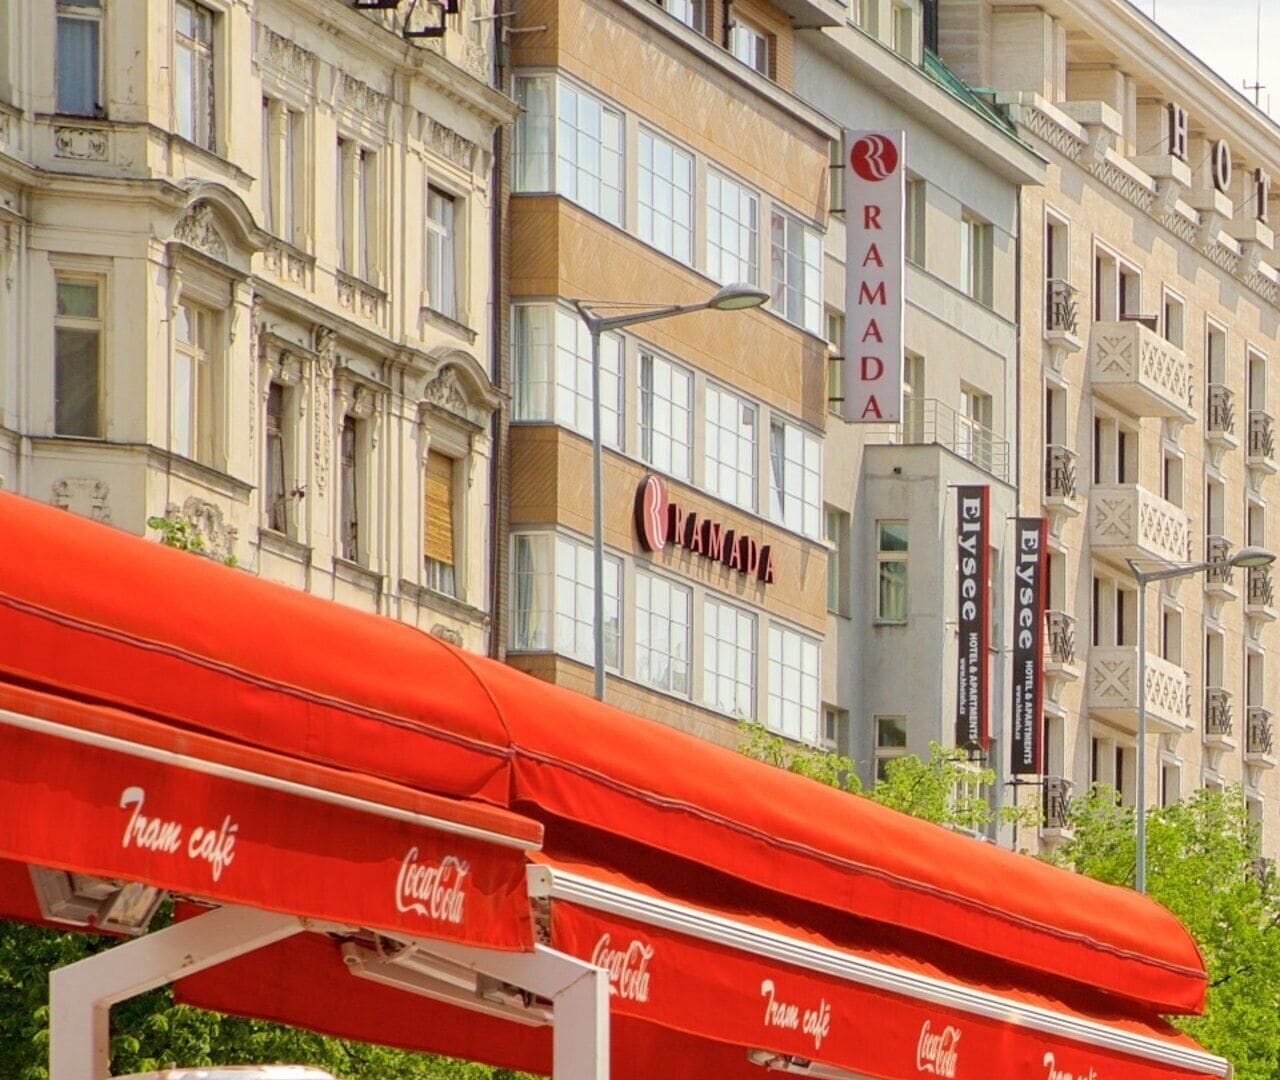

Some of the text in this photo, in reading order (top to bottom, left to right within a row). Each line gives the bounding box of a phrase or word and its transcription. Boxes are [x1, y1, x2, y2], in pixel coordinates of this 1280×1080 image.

[858, 204, 887, 419] RAMADA
[668, 503, 776, 584] RAMADA
[958, 498, 981, 621] Elysee
[1016, 529, 1039, 649] Elysee
[968, 632, 978, 665] HOTEL
[1025, 660, 1034, 690] HOTEL
[968, 675, 978, 740] APARTMENTS
[1023, 702, 1033, 765] APARTMENTS
[119, 787, 238, 882] Tram café
[761, 979, 831, 1050] Tram café
